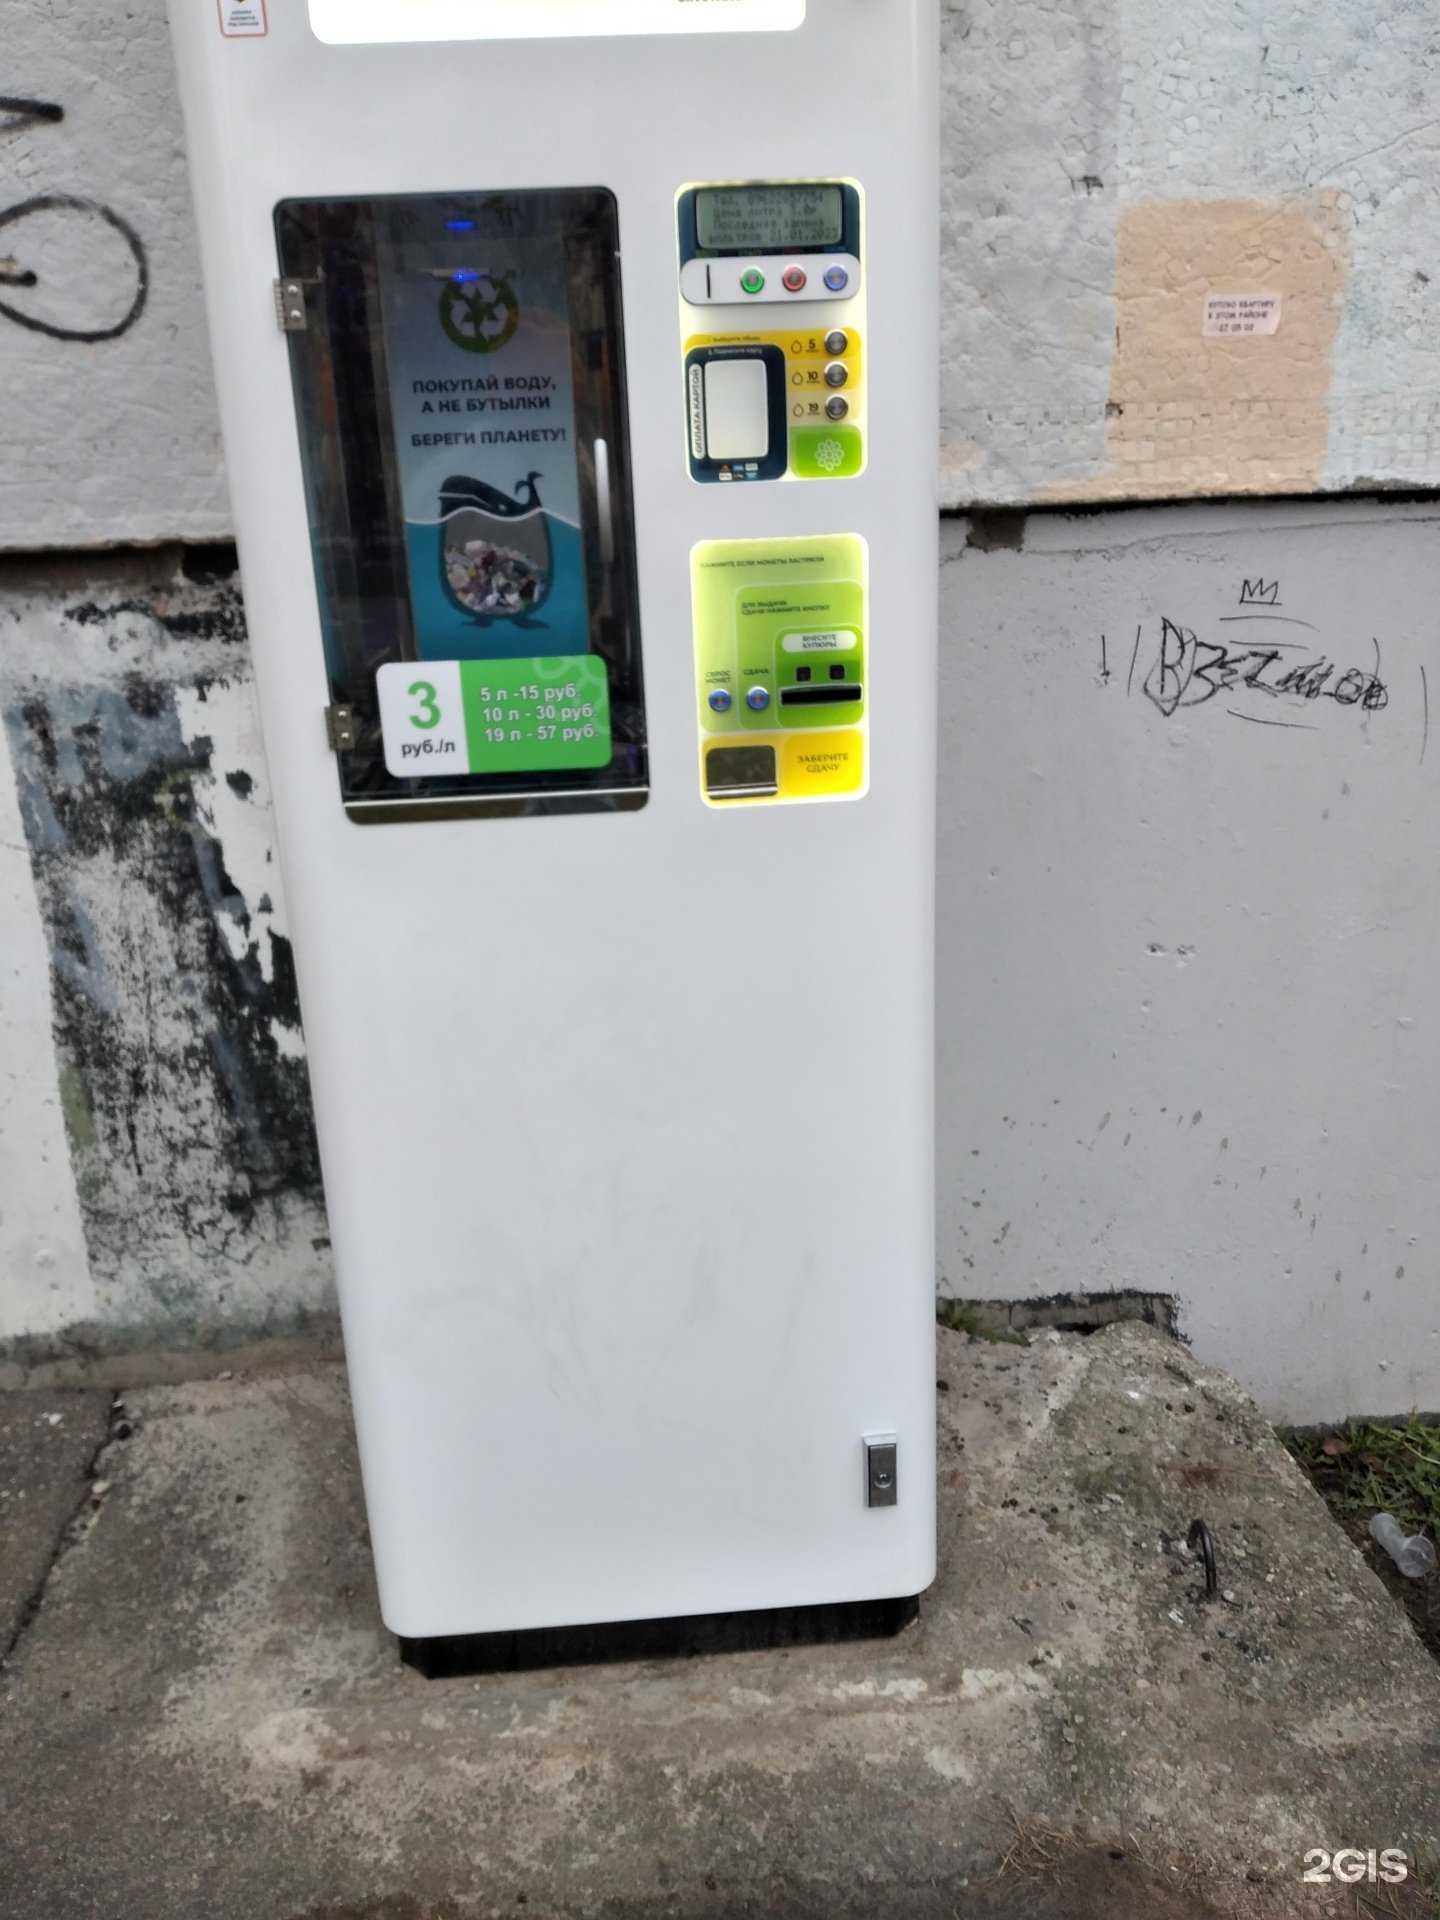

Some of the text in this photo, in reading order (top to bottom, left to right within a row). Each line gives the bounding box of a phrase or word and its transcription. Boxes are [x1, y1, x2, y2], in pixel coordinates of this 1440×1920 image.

[808, 339, 817, 349] 5
[807, 371, 819, 380] 10
[412, 374, 557, 394] ПОКУПАЙ ВОДУ,
[421, 396, 551, 414] А НЕ БУТЫЛКИ
[808, 403, 819, 412] 19
[411, 428, 566, 447] БЕРЕГИ ПЛАНЕТУ!
[802, 641, 837, 649] КУПЮРЫ
[480, 687, 491, 702] 5
[495, 688, 507, 700] л
[407, 681, 441, 730] 3
[482, 707, 503, 722] 10
[508, 709, 520, 721] л
[536, 705, 556, 720] 30
[485, 728, 504, 743] 19
[510, 730, 522, 741] л
[537, 726, 557, 740] 57
[401, 737, 456, 758] руб./л
[798, 753, 849, 764] ЗАБЕРИТЕ
[806, 763, 840, 773] СДАЧУ
